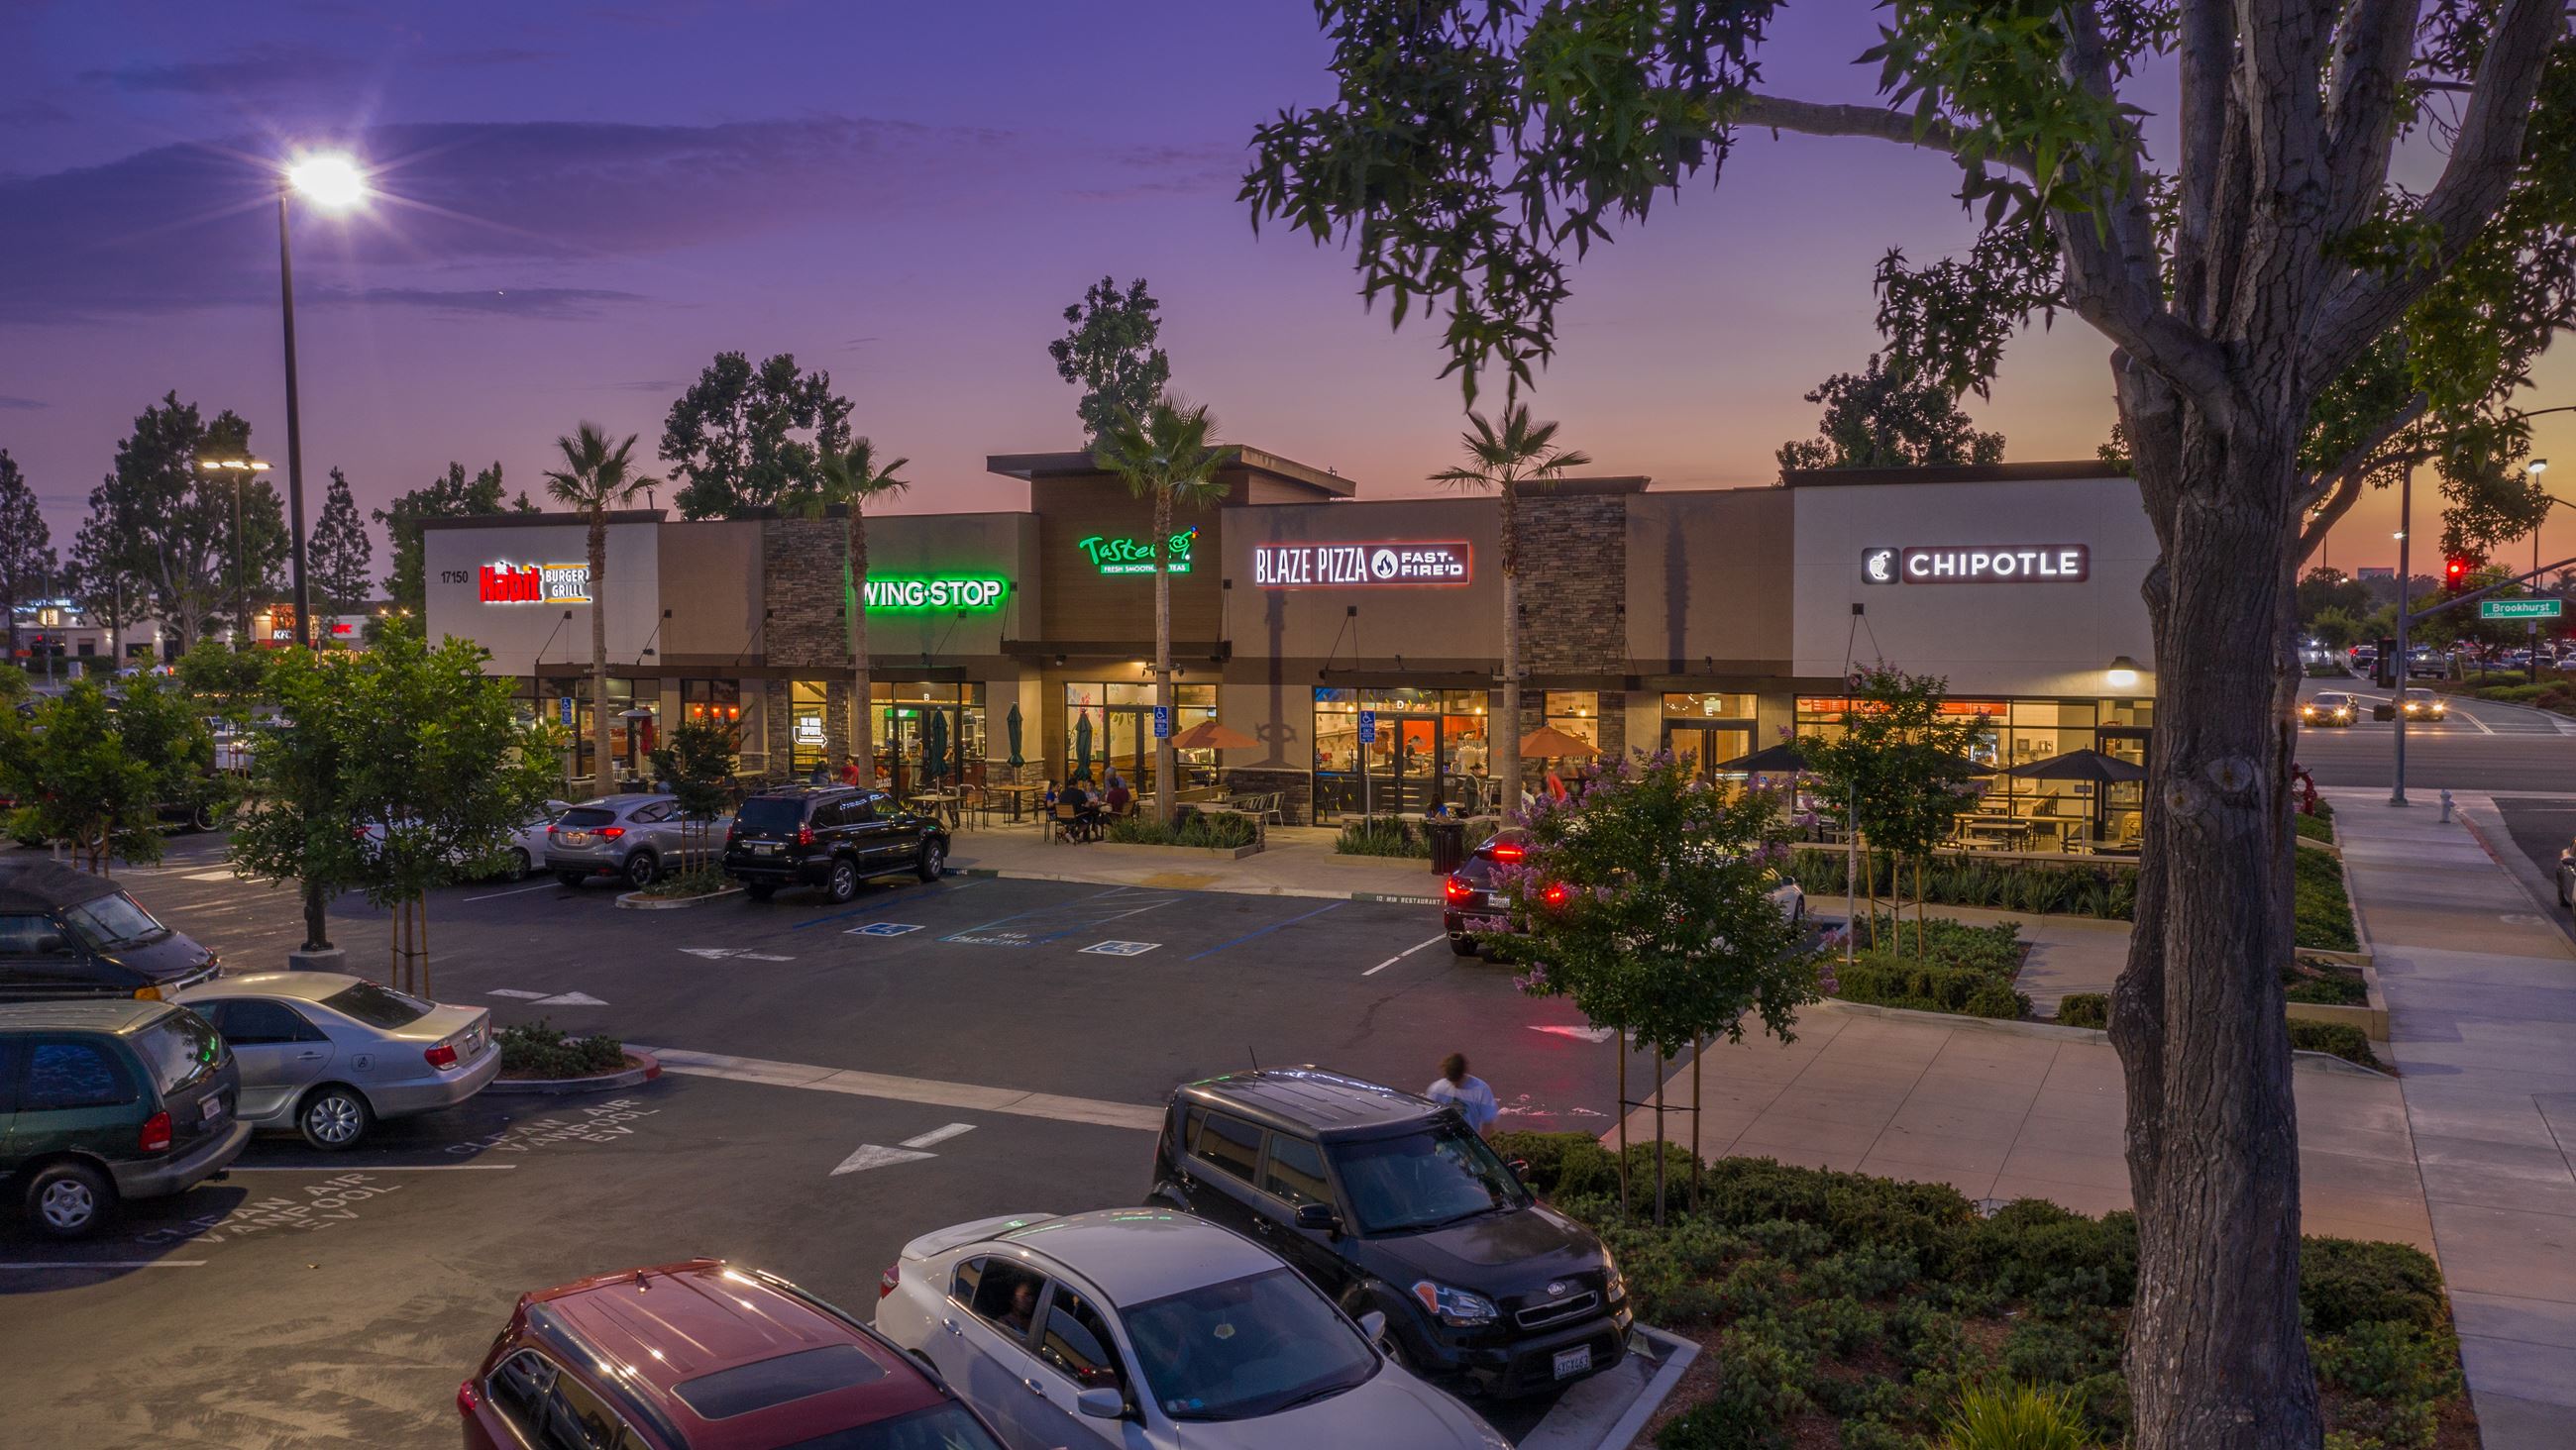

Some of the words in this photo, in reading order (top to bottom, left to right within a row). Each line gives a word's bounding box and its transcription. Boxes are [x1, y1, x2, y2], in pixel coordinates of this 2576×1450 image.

[1256, 549, 1311, 583] BLAZE
[1318, 548, 1368, 582] PIZZA
[1401, 552, 1454, 564] FAST-
[1909, 552, 2079, 576] CHIPOTLE
[440, 570, 469, 584] 17150
[545, 570, 585, 582] BURGER
[1401, 565, 1463, 576] FIRE'D
[479, 565, 541, 603] Habit
[551, 584, 583, 597] GRILL
[2492, 602, 2550, 612] Brookhurst
[1397, 700, 1404, 709] D
[1705, 707, 1713, 716] E
[1400, 896, 1441, 905] RESTAURANT
[445, 1119, 569, 1154] CLEAN
[583, 1098, 642, 1117] AIR
[497, 1109, 662, 1152] VANPOOL
[580, 1126, 635, 1143] EV
[135, 1196, 296, 1244] CLEAN
[303, 1173, 376, 1196] AIR
[190, 1185, 403, 1244] VANPOOL
[291, 1207, 360, 1231] EV
